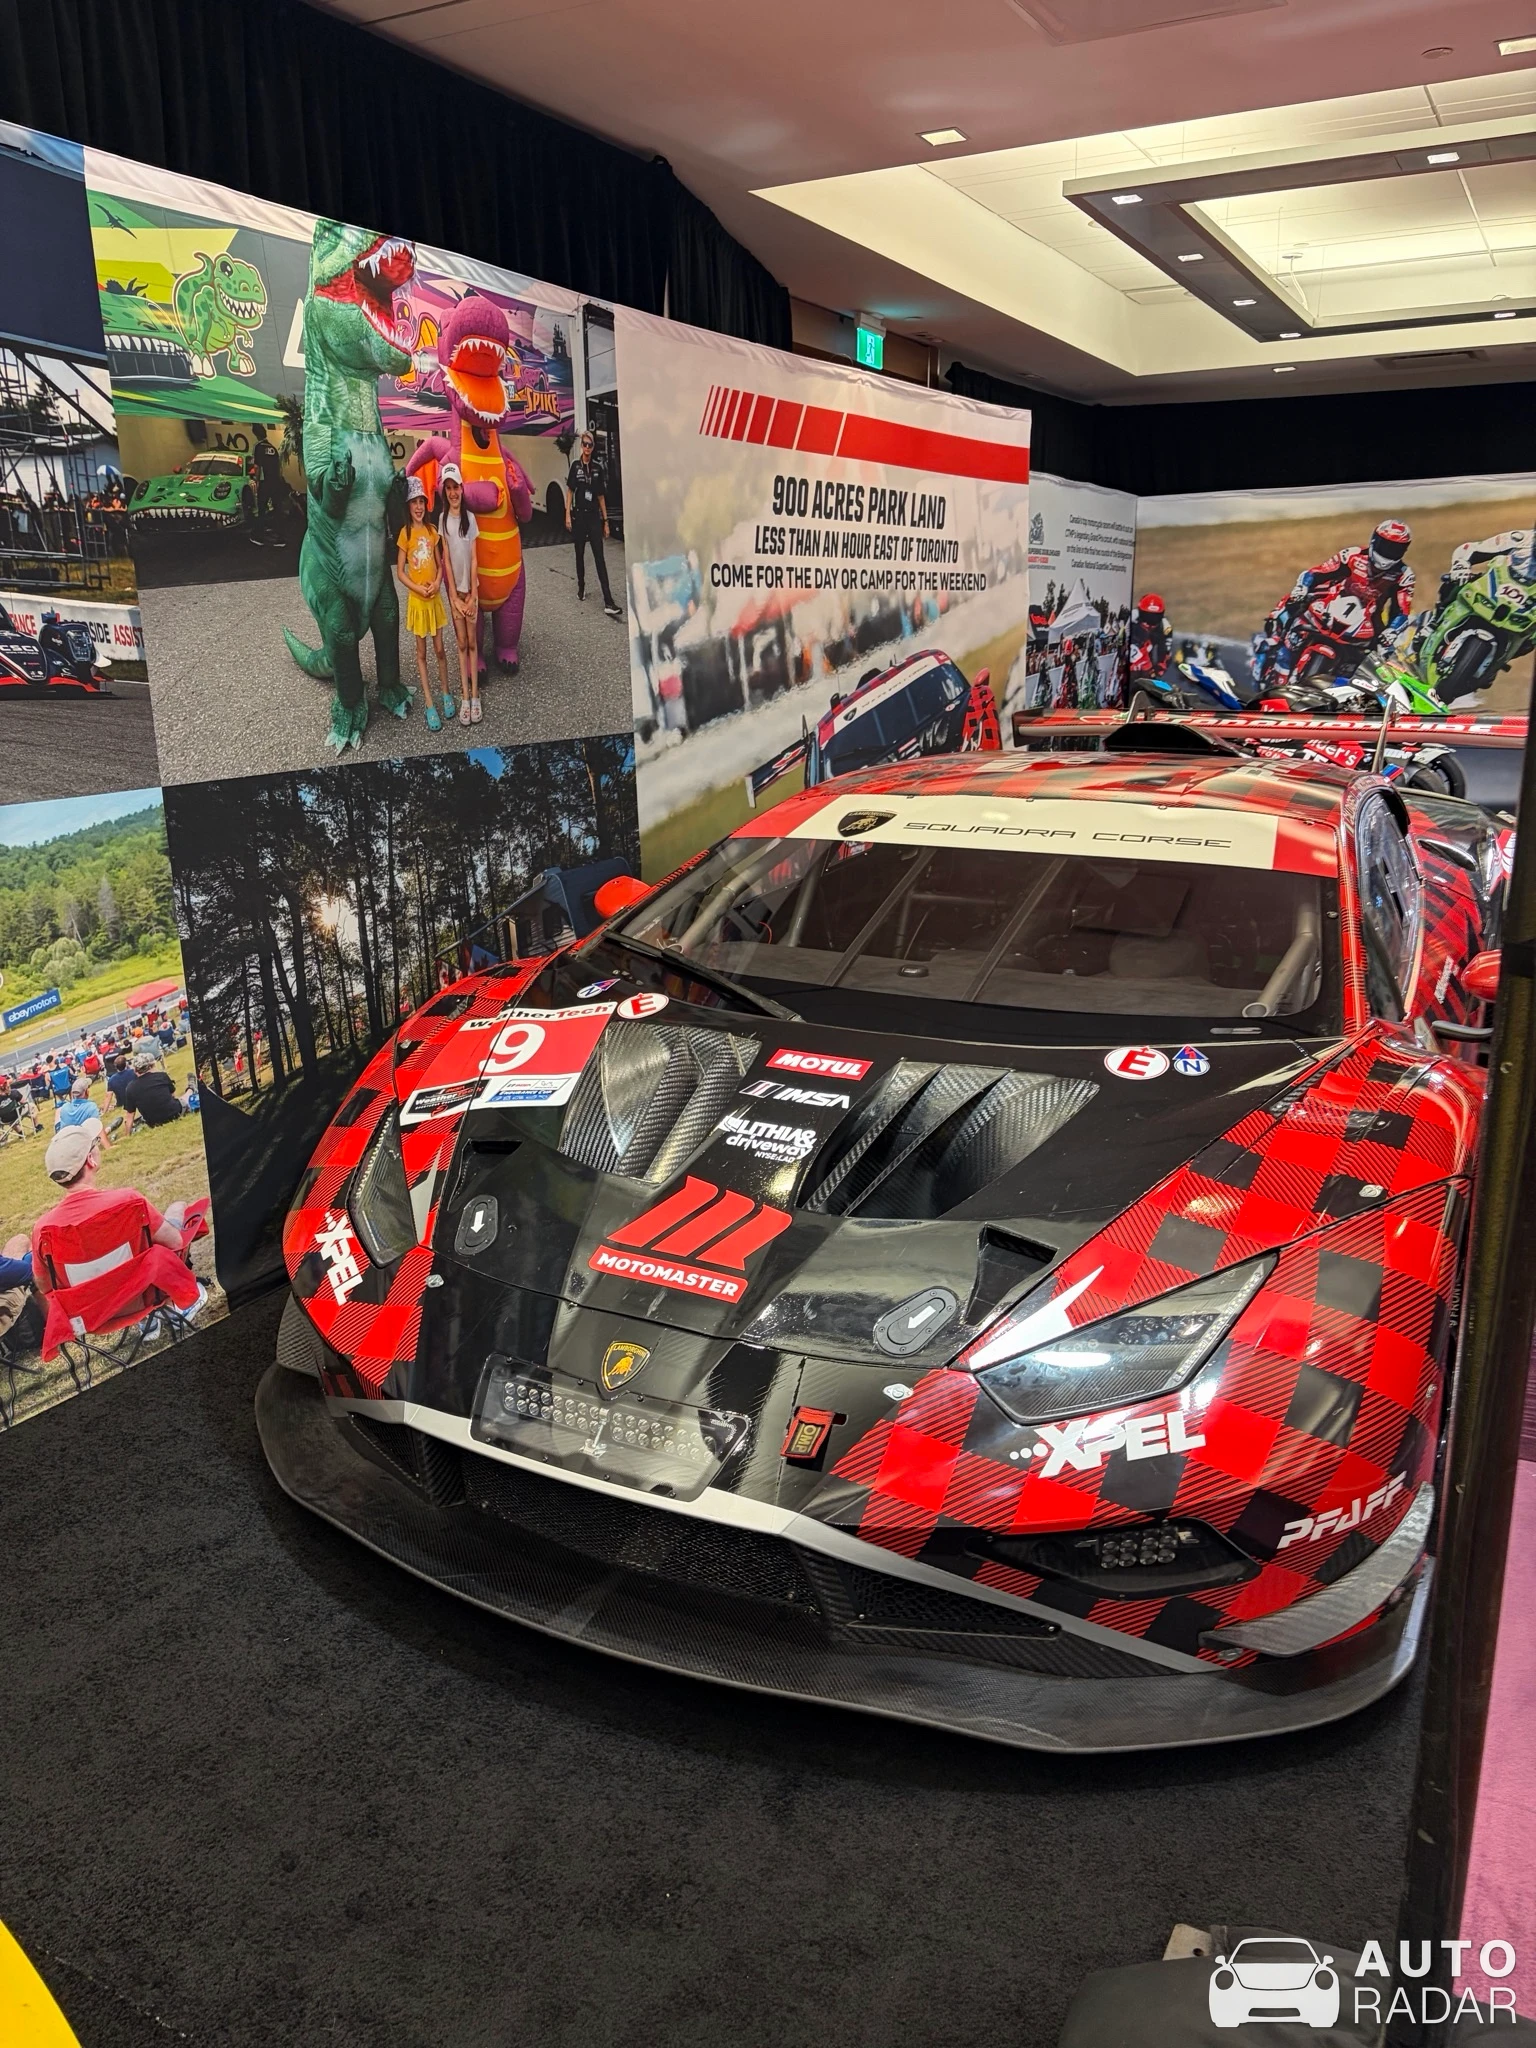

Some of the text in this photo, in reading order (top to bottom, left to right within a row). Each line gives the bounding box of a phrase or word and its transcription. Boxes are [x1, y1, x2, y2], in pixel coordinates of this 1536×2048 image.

[525, 386, 560, 418] SPIKE
[773, 475, 946, 530] 900 ACRES PARK LAND
[755, 525, 959, 564] LESS THAN AN HOUR EAST OF TORONTO
[710, 563, 987, 592] COME FOR THE DAY OR CAMP FOR THE WEEKEND
[902, 821, 1232, 848] SQUADRA CORSE
[478, 1022, 546, 1074] 9
[774, 1053, 862, 1076] MOTUL
[773, 1087, 850, 1109] IMSA
[726, 1134, 811, 1160] driveway
[315, 1213, 364, 1307] XPEL
[597, 1252, 739, 1297] MOTOMASTER
[795, 1424, 817, 1453] OMP
[1034, 1410, 1206, 1478] XPEL
[1276, 1470, 1407, 1550] PFAFF
